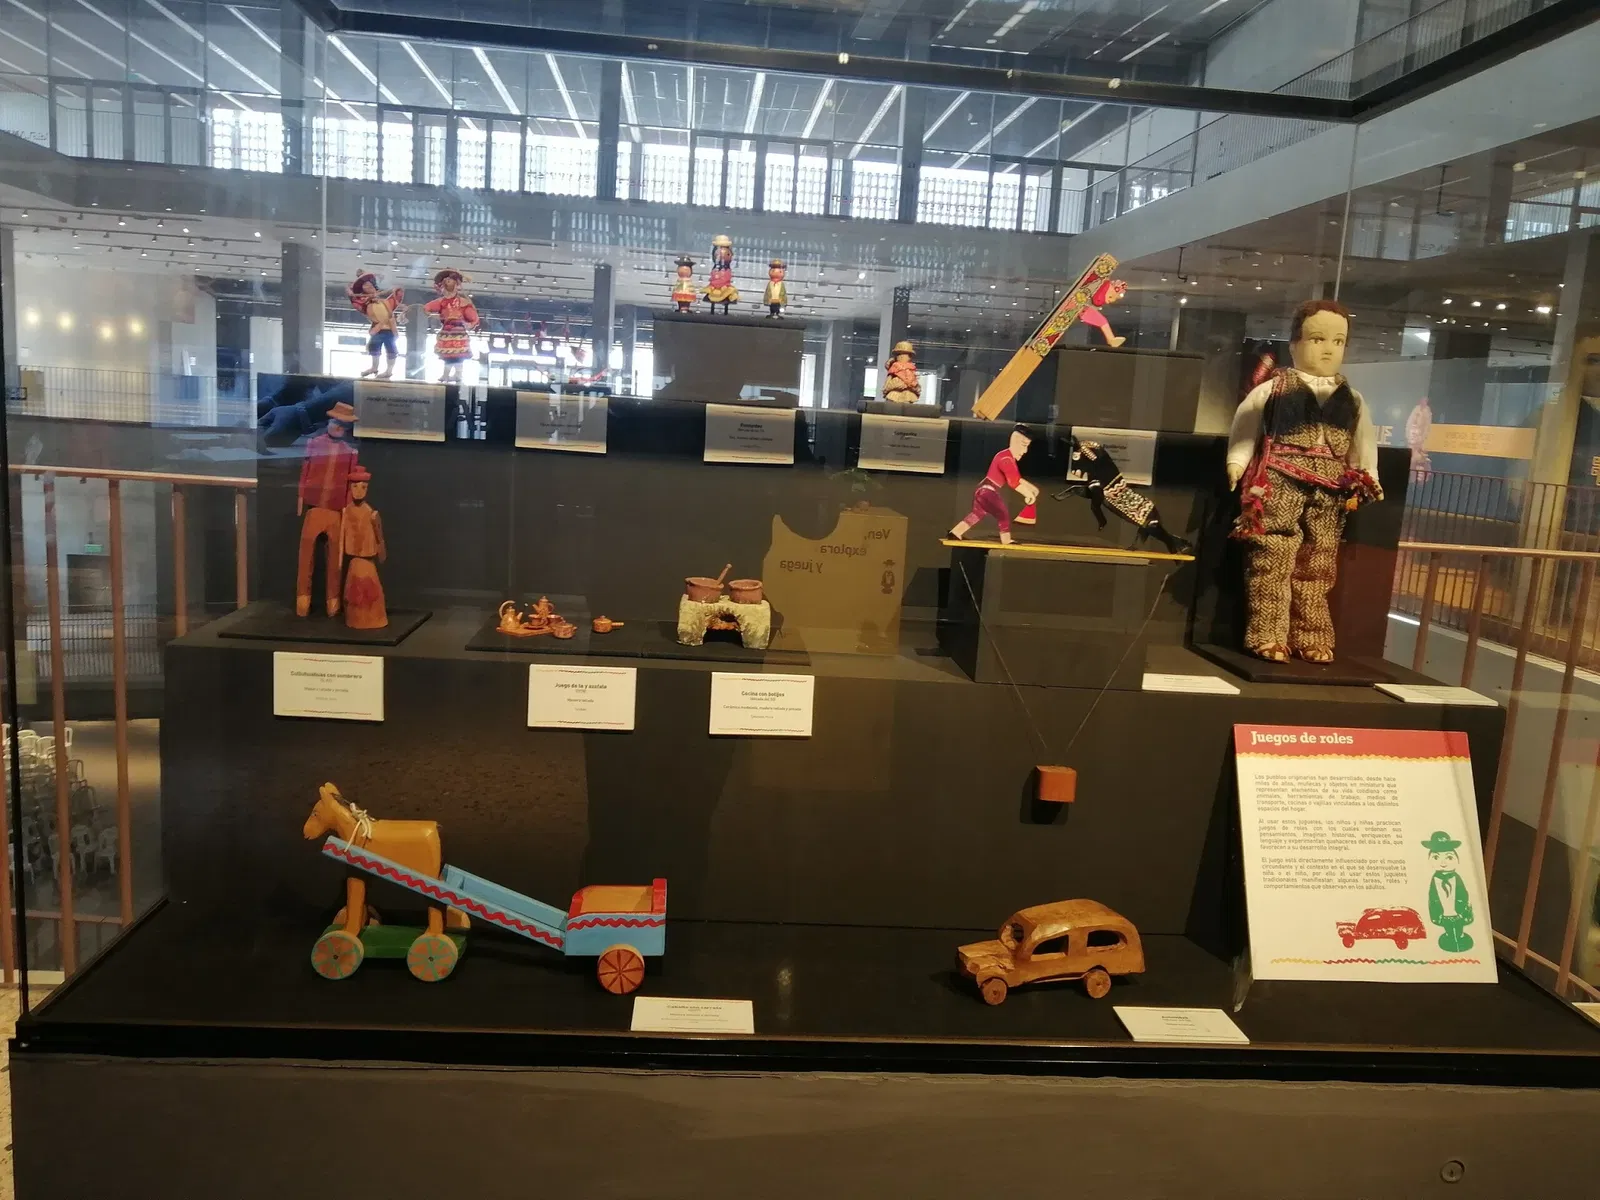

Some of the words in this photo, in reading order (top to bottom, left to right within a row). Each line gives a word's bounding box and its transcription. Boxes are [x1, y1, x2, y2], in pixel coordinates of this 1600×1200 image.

[1251, 731, 1297, 746] Juegos
[1300, 732, 1317, 743] de
[1320, 733, 1353, 744] roles
